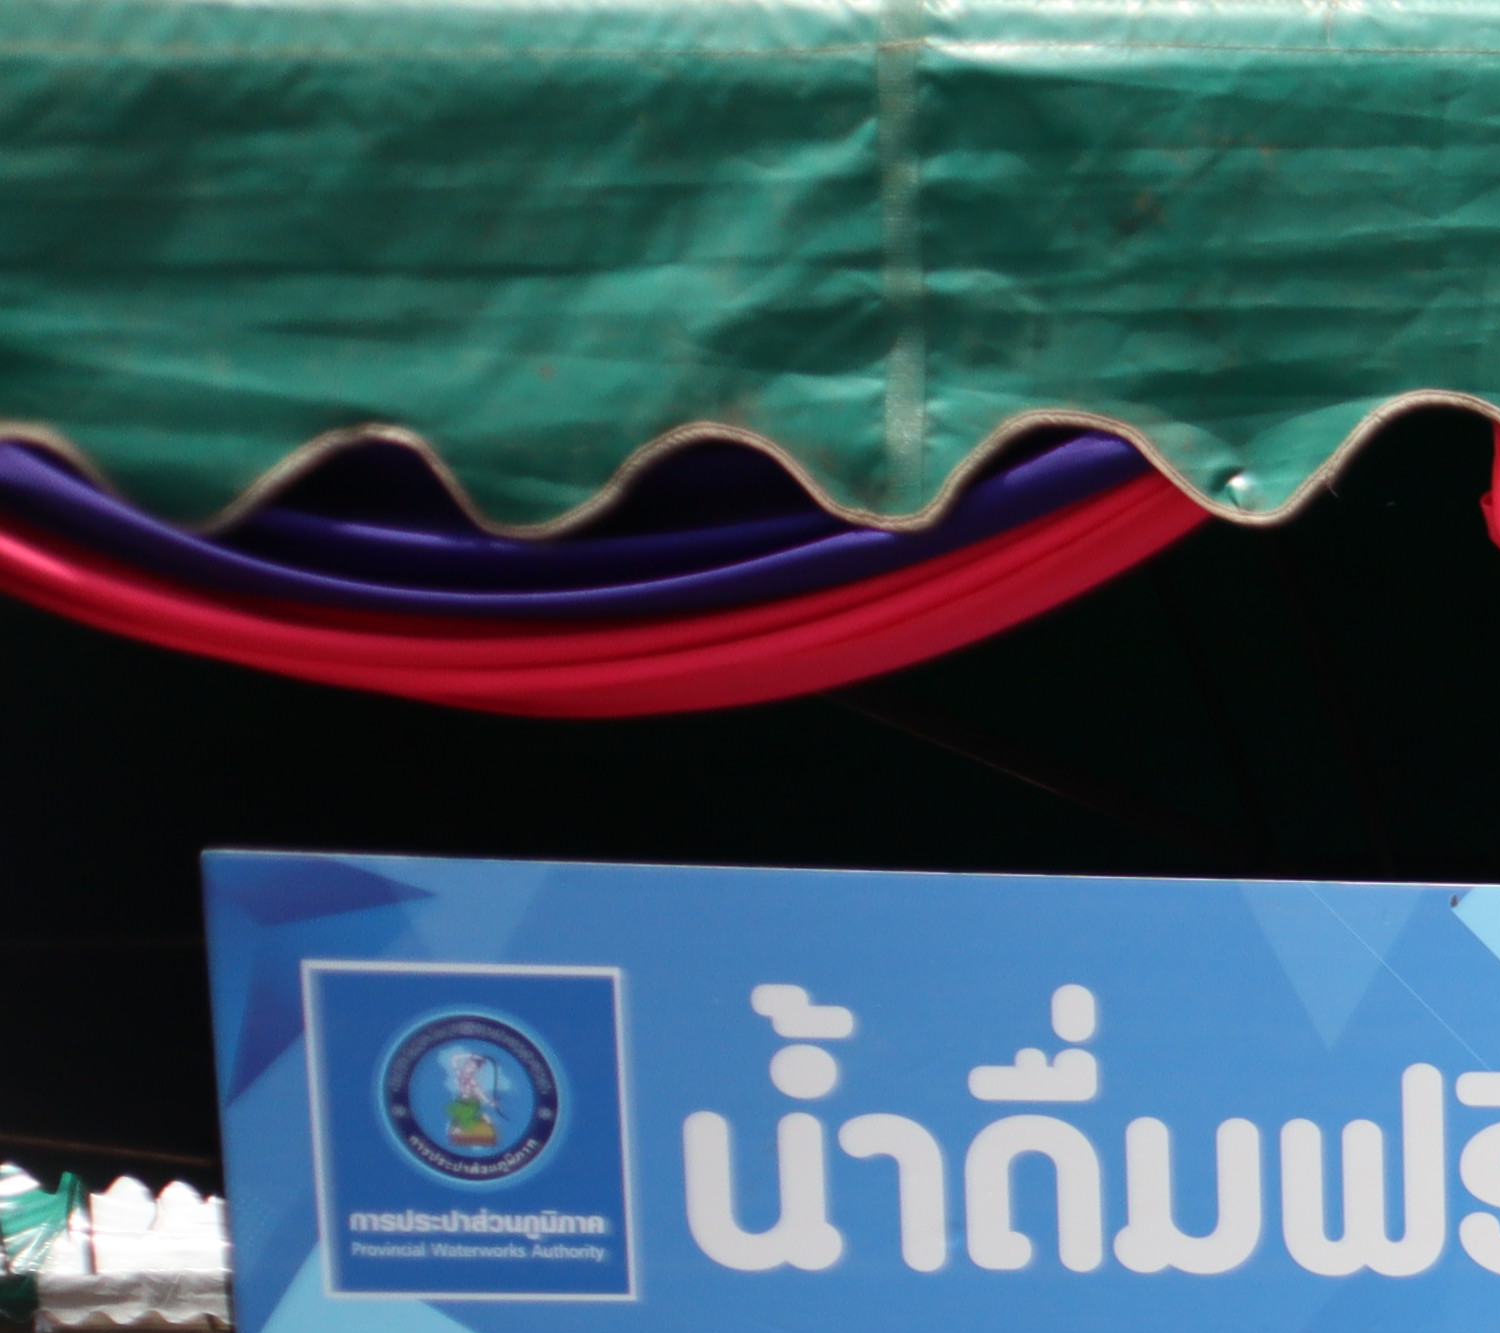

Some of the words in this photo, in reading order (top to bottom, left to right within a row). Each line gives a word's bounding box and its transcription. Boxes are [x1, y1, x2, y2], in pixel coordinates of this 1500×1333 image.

[348, 1206, 607, 1241] การประปาส่วนภูมิภาค
[350, 1241, 427, 1259] Provincial
[431, 1243, 527, 1260] Waterworks
[531, 1244, 606, 1263] Authority
